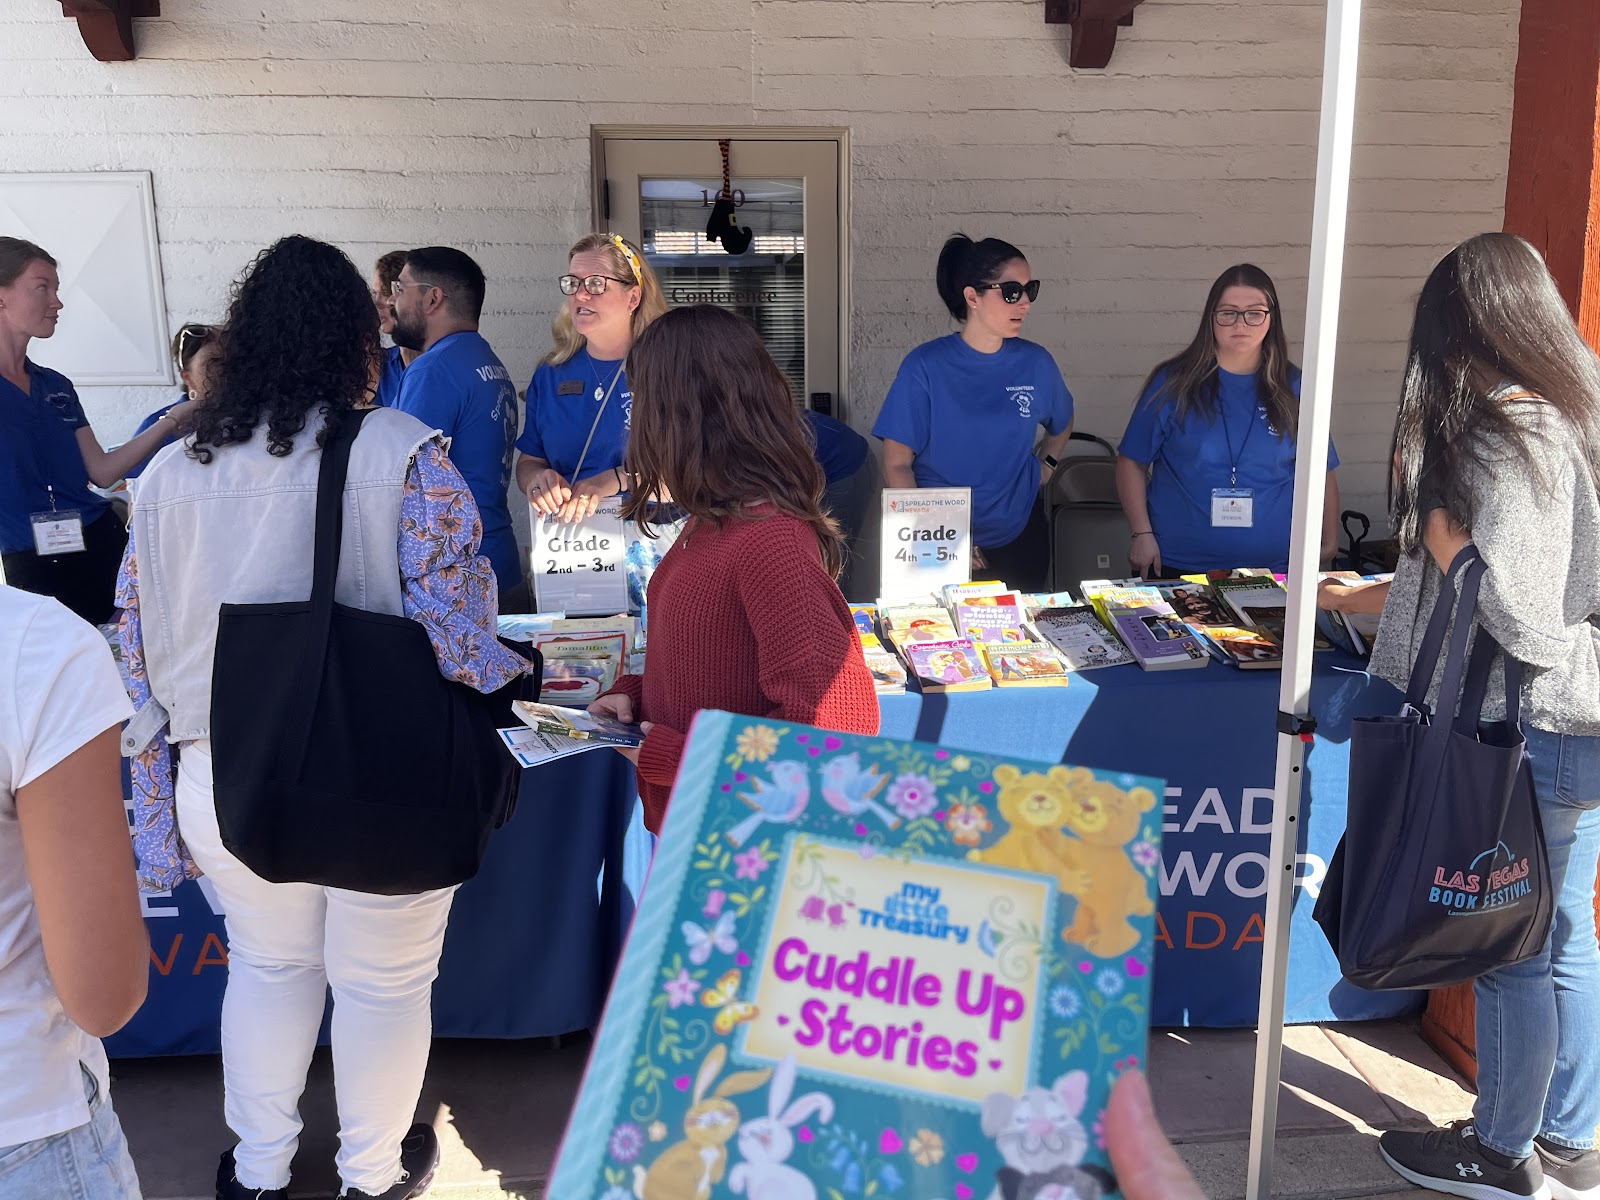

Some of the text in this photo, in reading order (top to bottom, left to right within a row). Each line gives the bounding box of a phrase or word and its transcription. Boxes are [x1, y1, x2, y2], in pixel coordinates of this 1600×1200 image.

[671, 287, 777, 303] Conference
[547, 534, 610, 553] Grade
[897, 525, 957, 542] Grade
[546, 559, 573, 575] 2nd
[592, 557, 615, 573] 3rd
[894, 547, 918, 562] 4th
[935, 546, 958, 562] 5th
[1433, 866, 1481, 893] LAS
[900, 881, 941, 904] my
[1428, 878, 1532, 910] BOOK FESTIVAL
[884, 892, 949, 922] little
[857, 907, 970, 944] Treasury
[772, 936, 1025, 1041] Cuddle Up
[794, 998, 979, 1078] Stories
